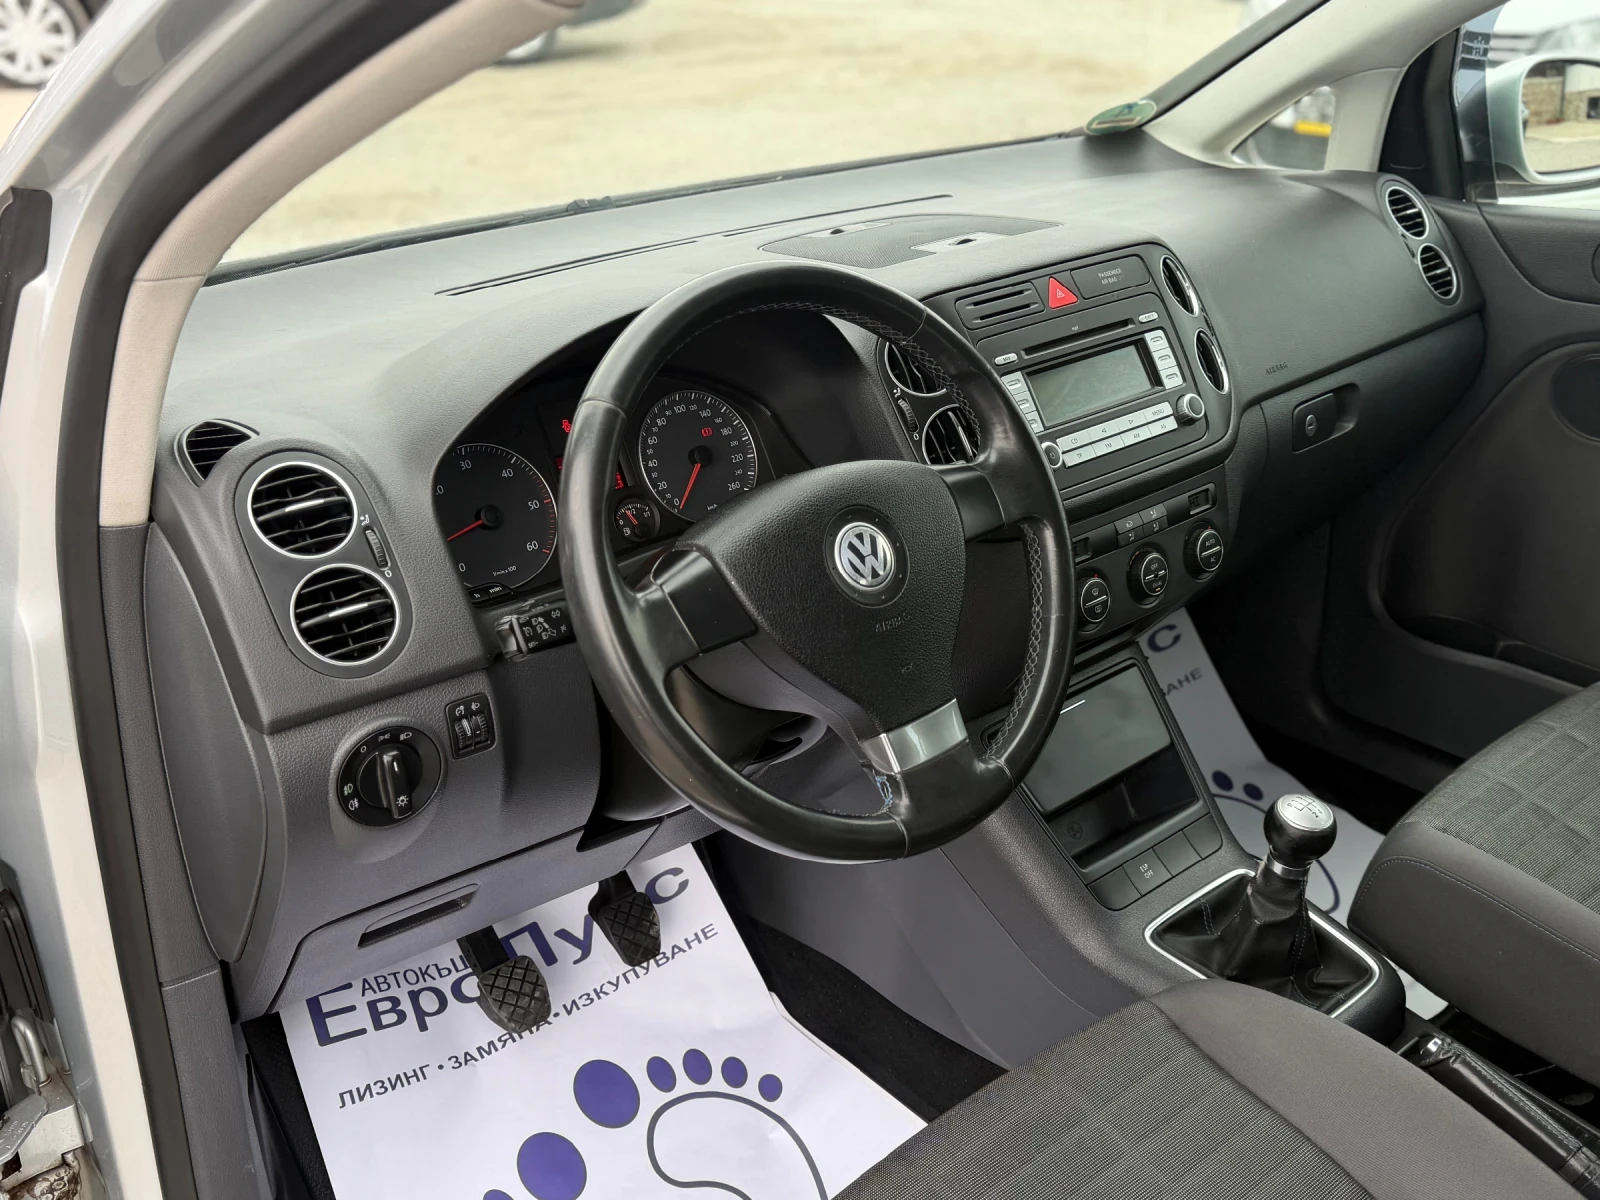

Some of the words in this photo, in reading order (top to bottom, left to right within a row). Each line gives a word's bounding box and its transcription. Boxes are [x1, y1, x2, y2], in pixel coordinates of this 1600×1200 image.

[673, 404, 686, 414] 100
[699, 409, 712, 418] 140
[1151, 408, 1165, 416] MENU
[656, 417, 667, 426] 80
[720, 427, 733, 436] 180
[647, 436, 658, 445] 60
[731, 453, 744, 463] 220
[460, 460, 472, 470] 30
[648, 459, 658, 467] 40
[501, 468, 514, 478] 40
[658, 481, 668, 490] 20
[727, 481, 741, 491] 260
[528, 500, 540, 510] 50
[673, 498, 680, 506] 0
[526, 541, 539, 551] 60
[1205, 538, 1216, 546] AUTO
[458, 562, 466, 572] 0
[1139, 863, 1148, 872] ESP
[1144, 869, 1154, 878] OFF
[338, 1063, 431, 1109] ЛИЗИНГ
[562, 922, 719, 1016] ИЗКУПУВАНЕ
